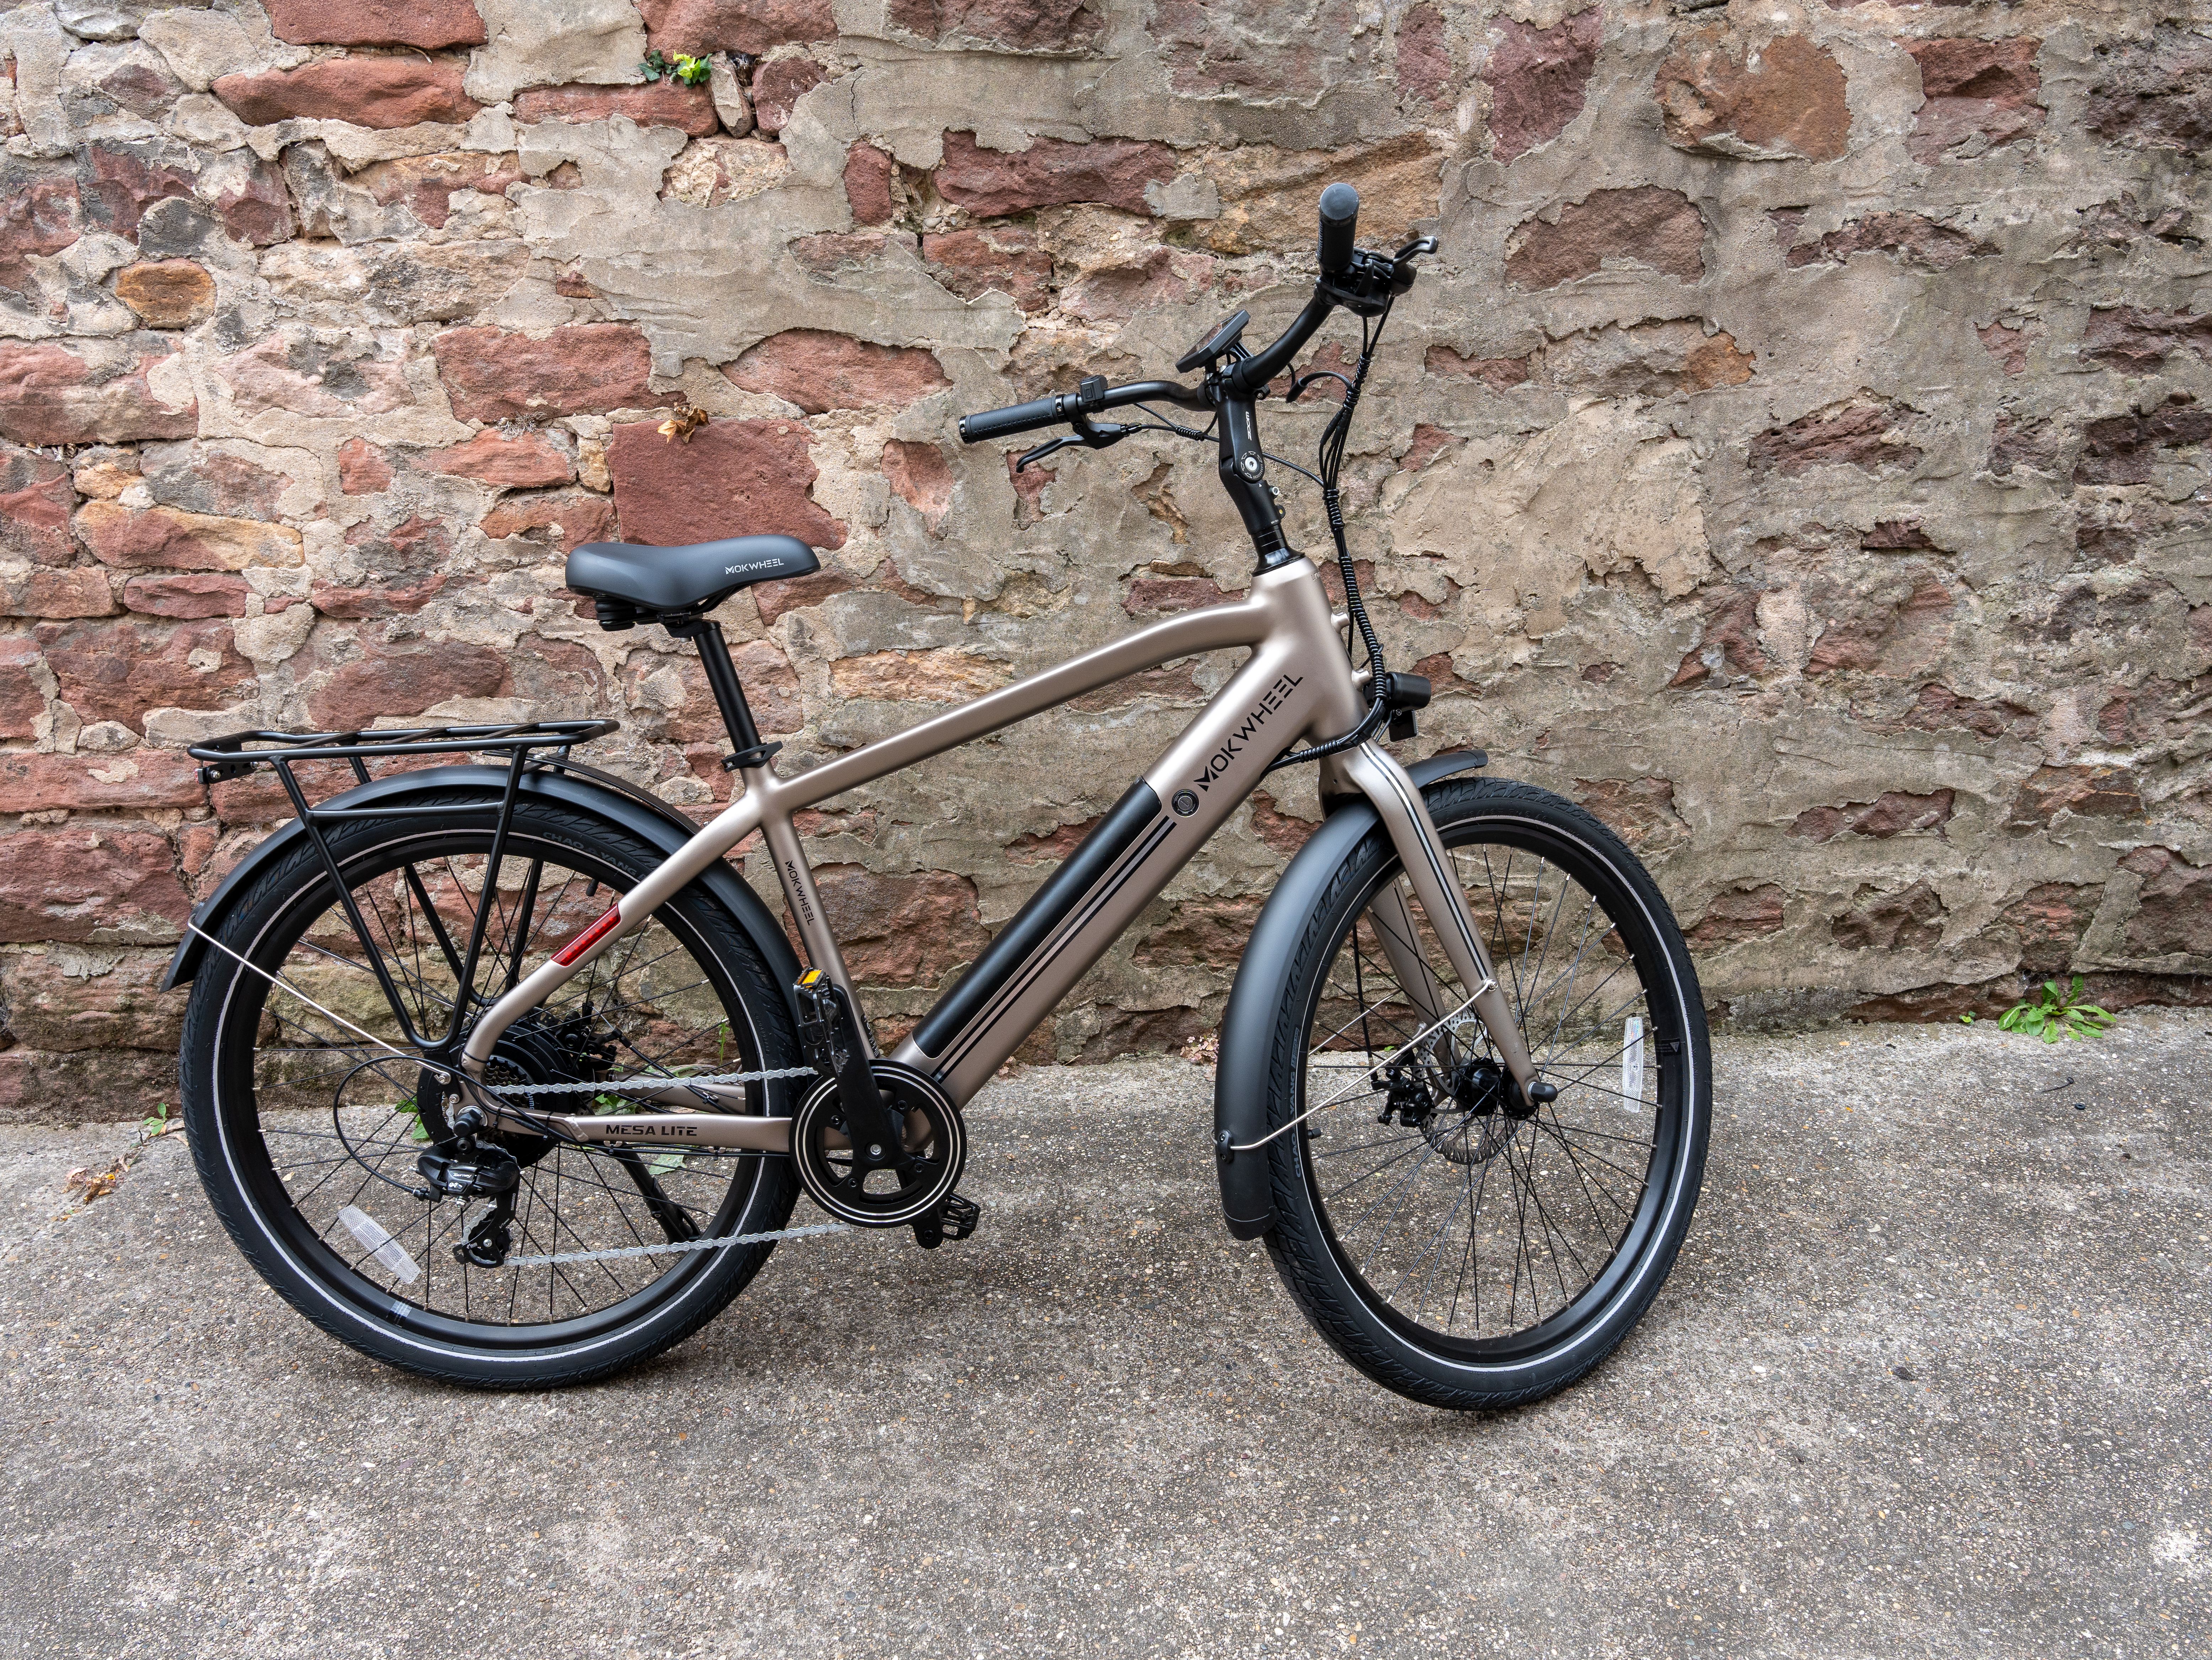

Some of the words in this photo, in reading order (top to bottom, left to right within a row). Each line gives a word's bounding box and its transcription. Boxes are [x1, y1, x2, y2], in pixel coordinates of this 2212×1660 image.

[725, 558, 784, 575] MOKWHEEL
[1193, 674, 1304, 792] MOKWHEEL
[543, 832, 584, 849] CHAO
[600, 852, 637, 876] YANG
[785, 859, 815, 926] MOKWHEEL
[606, 1124, 656, 1136] MESA
[661, 1126, 697, 1136] LITE
[1291, 1132, 1301, 1178] CHAO
